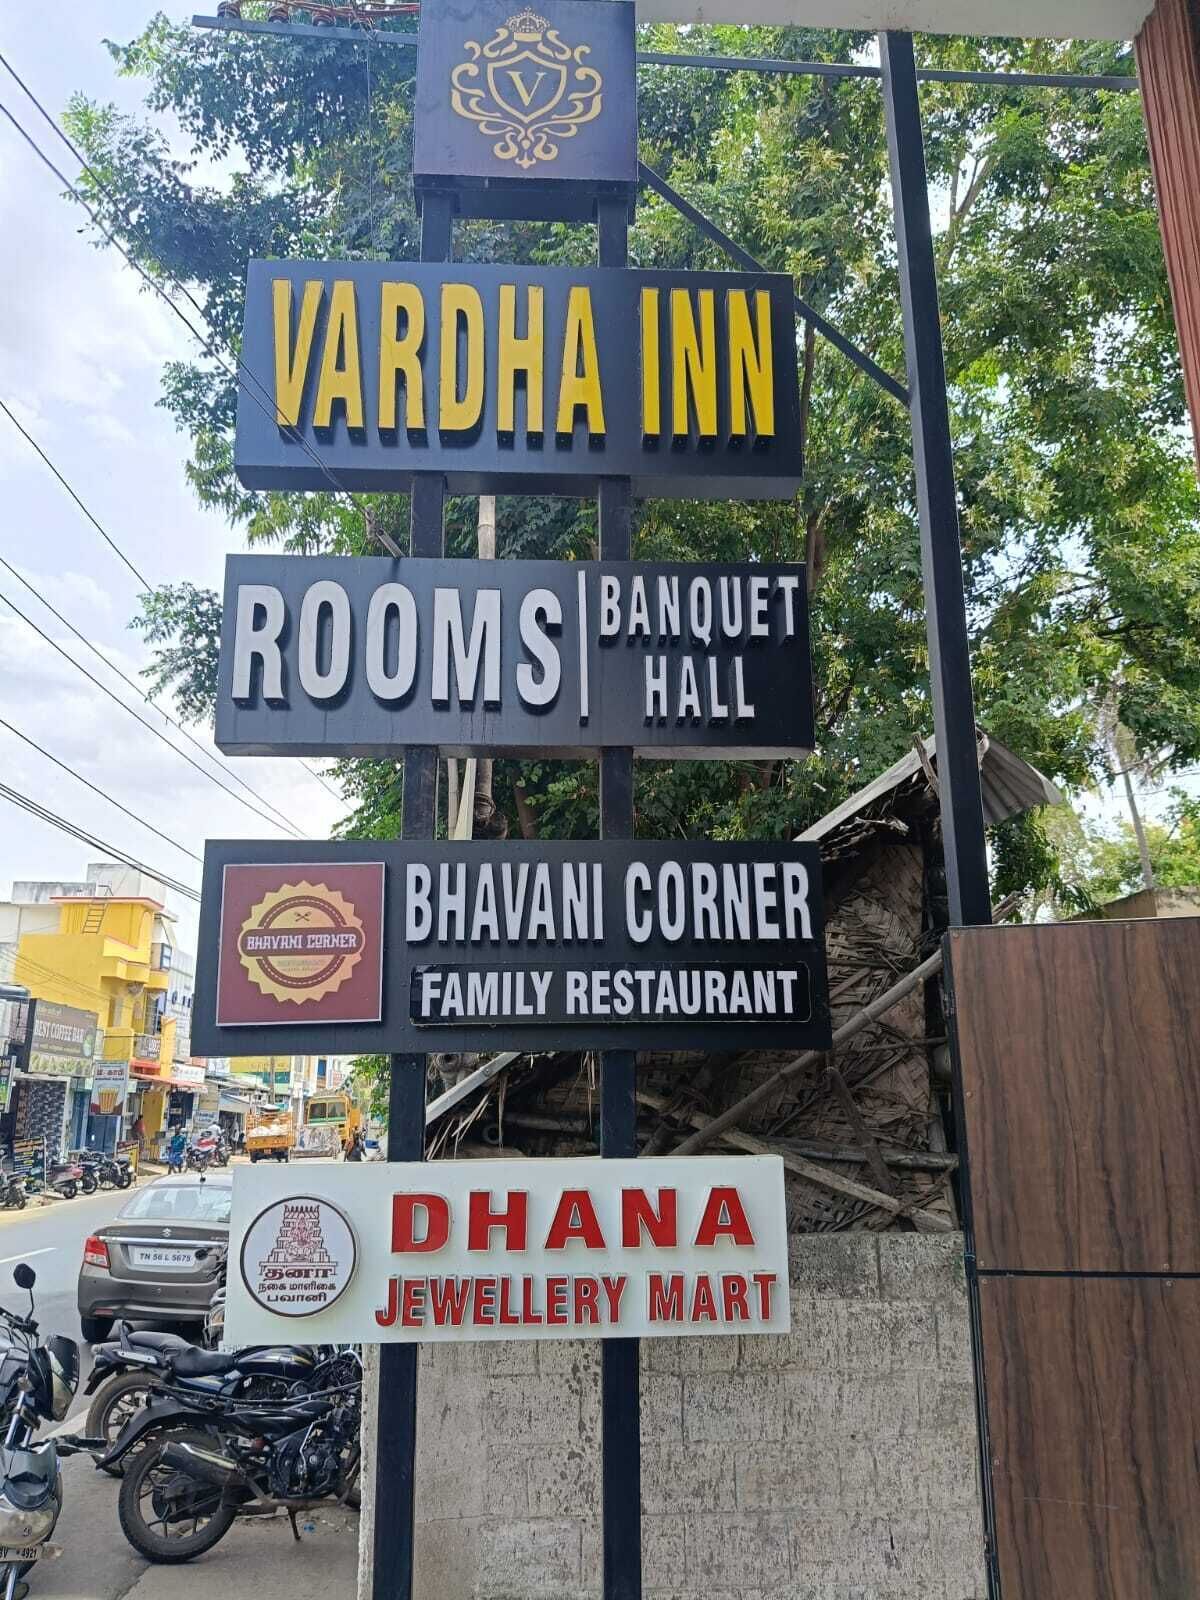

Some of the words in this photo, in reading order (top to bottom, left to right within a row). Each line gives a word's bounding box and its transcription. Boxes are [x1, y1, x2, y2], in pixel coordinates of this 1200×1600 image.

[507, 71, 547, 106] V
[272, 278, 607, 441] VARDHA
[639, 286, 775, 439] INN
[599, 575, 799, 646] BANQUET
[231, 580, 564, 708] ROOMS
[644, 655, 756, 721] HALL
[405, 862, 605, 943] BHAVANI
[625, 860, 813, 943] CORNER
[247, 935, 302, 950] BHAVANI
[307, 934, 357, 948] CORNER
[421, 971, 553, 1017] FAMILY
[566, 970, 798, 1015] RESTAURANT
[50, 1023, 71, 1041] COFFEE
[391, 1185, 755, 1254] DHANA
[258, 1282, 287, 1294] நகை
[289, 1280, 336, 1291] மாளிகை
[263, 1267, 333, 1281] தனா
[267, 1292, 327, 1303] பவானி
[375, 1273, 628, 1327] JEWELLERY
[647, 1271, 777, 1322] MART
